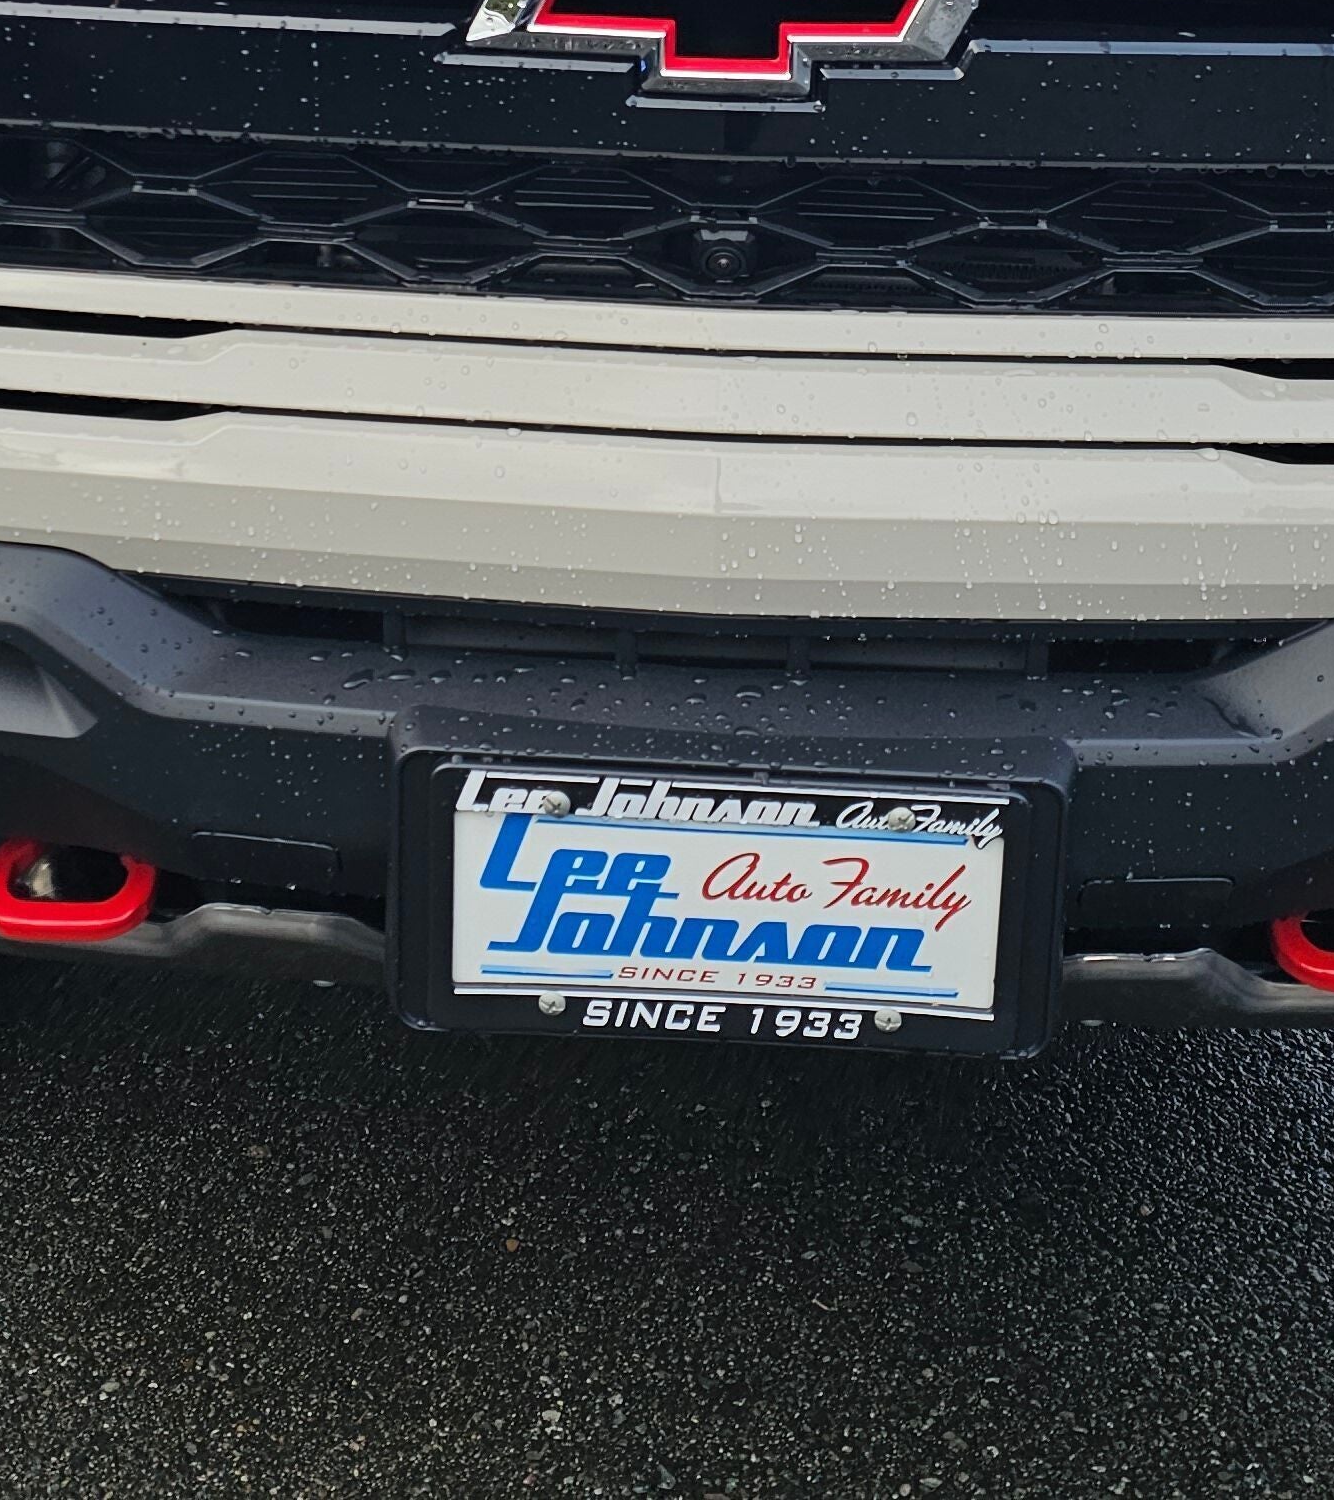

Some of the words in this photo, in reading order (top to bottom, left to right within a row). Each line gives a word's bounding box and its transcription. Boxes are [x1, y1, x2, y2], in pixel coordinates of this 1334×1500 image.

[575, 776, 820, 827] Johnson
[836, 801, 905, 831] Aut
[908, 804, 1003, 849] Family
[480, 813, 679, 900] Lee
[702, 852, 813, 904] Auto
[822, 857, 972, 932] Family
[487, 888, 932, 973] Johnson
[618, 966, 719, 984] SINCE
[737, 972, 817, 990] 1933
[582, 1000, 726, 1032] SINCE
[749, 1006, 863, 1040] 1933
